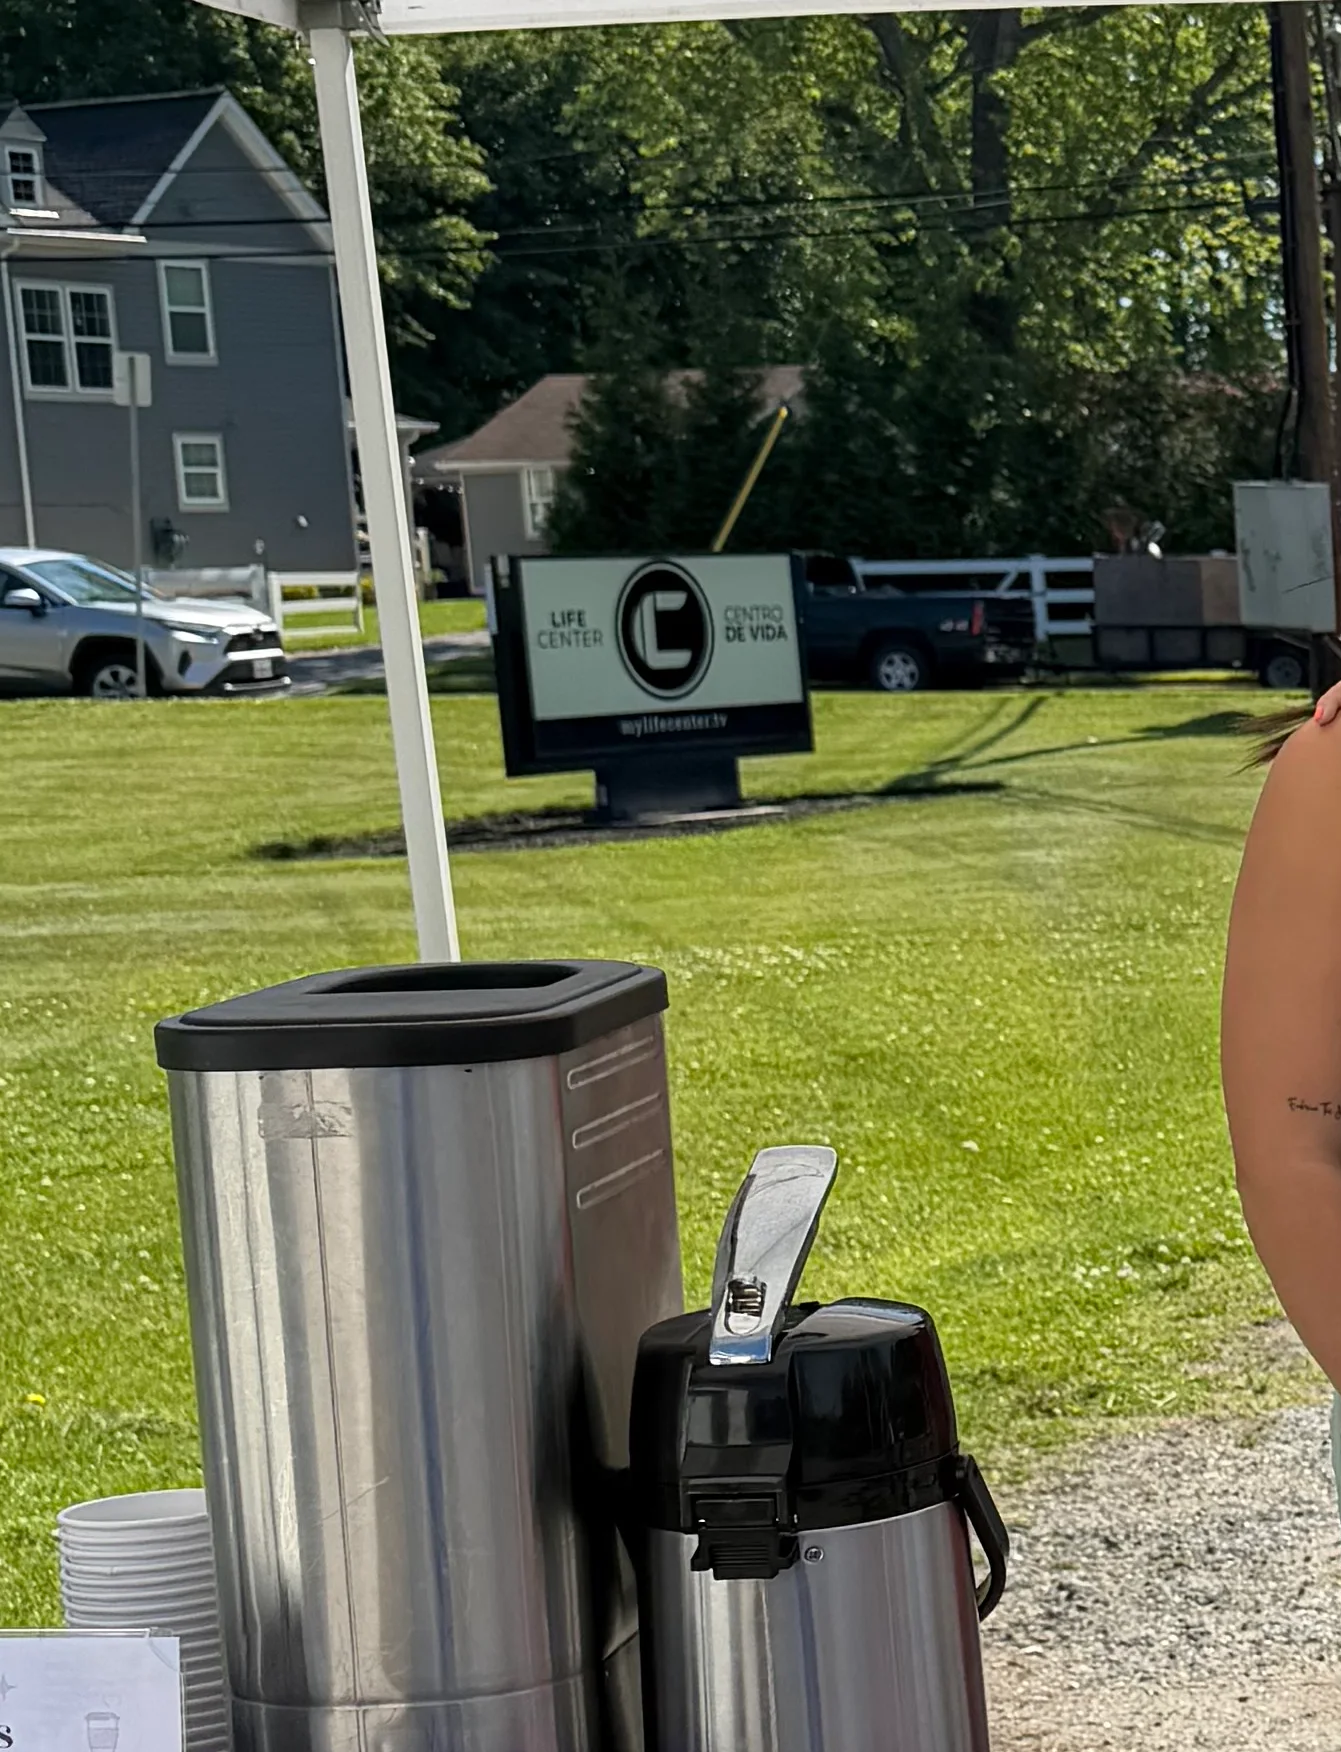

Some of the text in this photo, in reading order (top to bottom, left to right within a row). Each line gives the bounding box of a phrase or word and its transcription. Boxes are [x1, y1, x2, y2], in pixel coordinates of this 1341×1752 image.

[551, 610, 587, 628] LIFE
[723, 605, 784, 623] CENTRO
[537, 630, 604, 649] CENTER
[725, 625, 788, 643] DE VIDA
